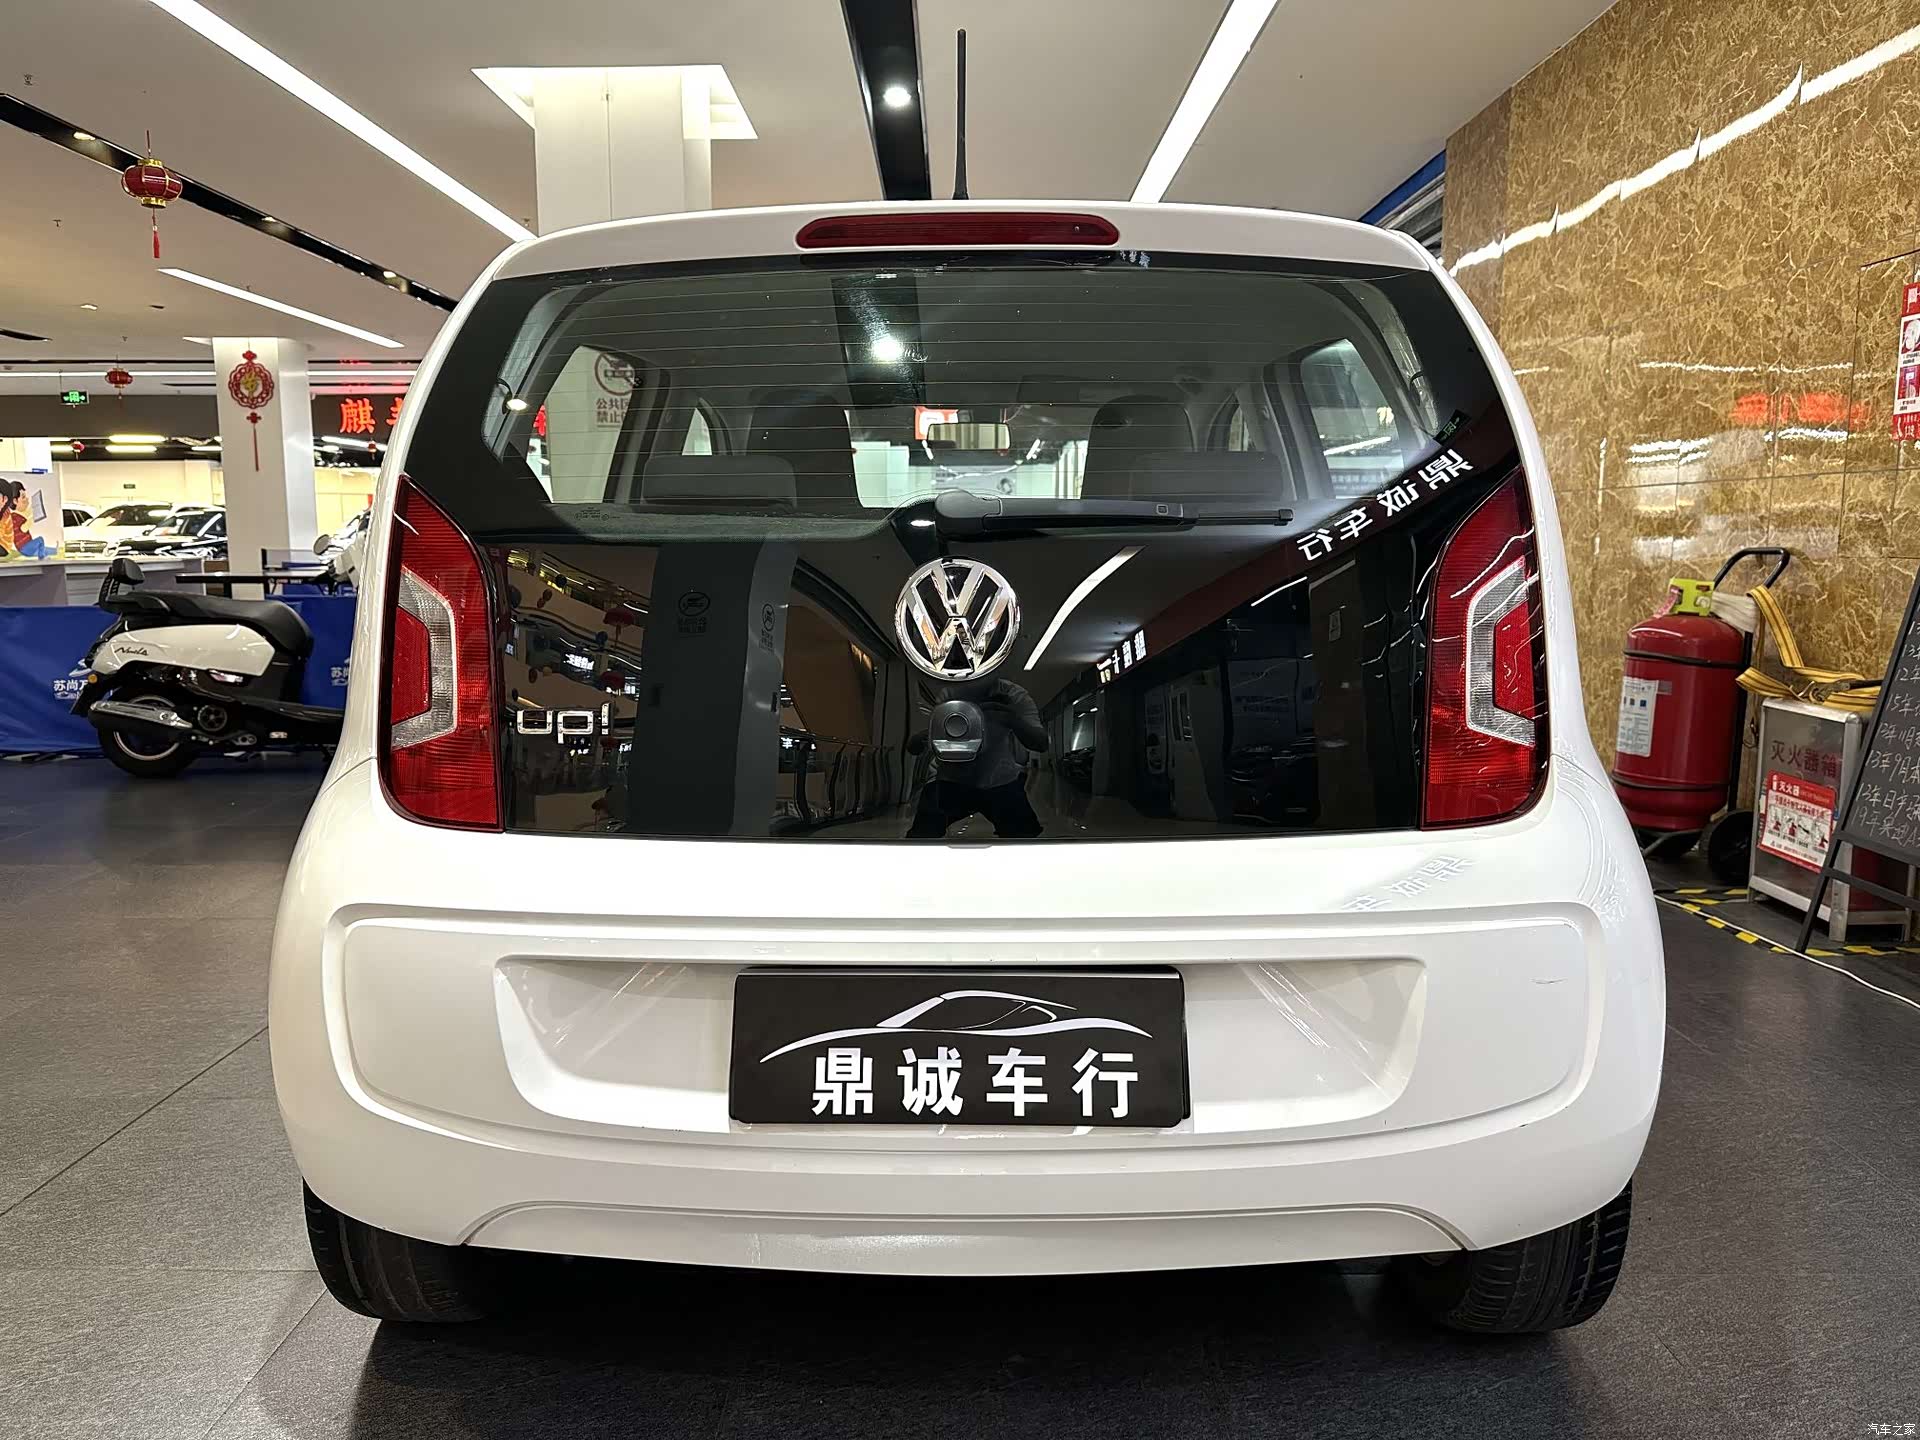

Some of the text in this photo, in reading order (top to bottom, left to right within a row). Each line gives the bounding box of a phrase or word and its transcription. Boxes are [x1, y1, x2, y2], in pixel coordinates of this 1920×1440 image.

[516, 701, 611, 744] up!
[1770, 740, 1838, 778] 灭火器箱
[1779, 781, 1800, 797] 灭火器
[811, 1046, 1139, 1119] 鼎诚车行
